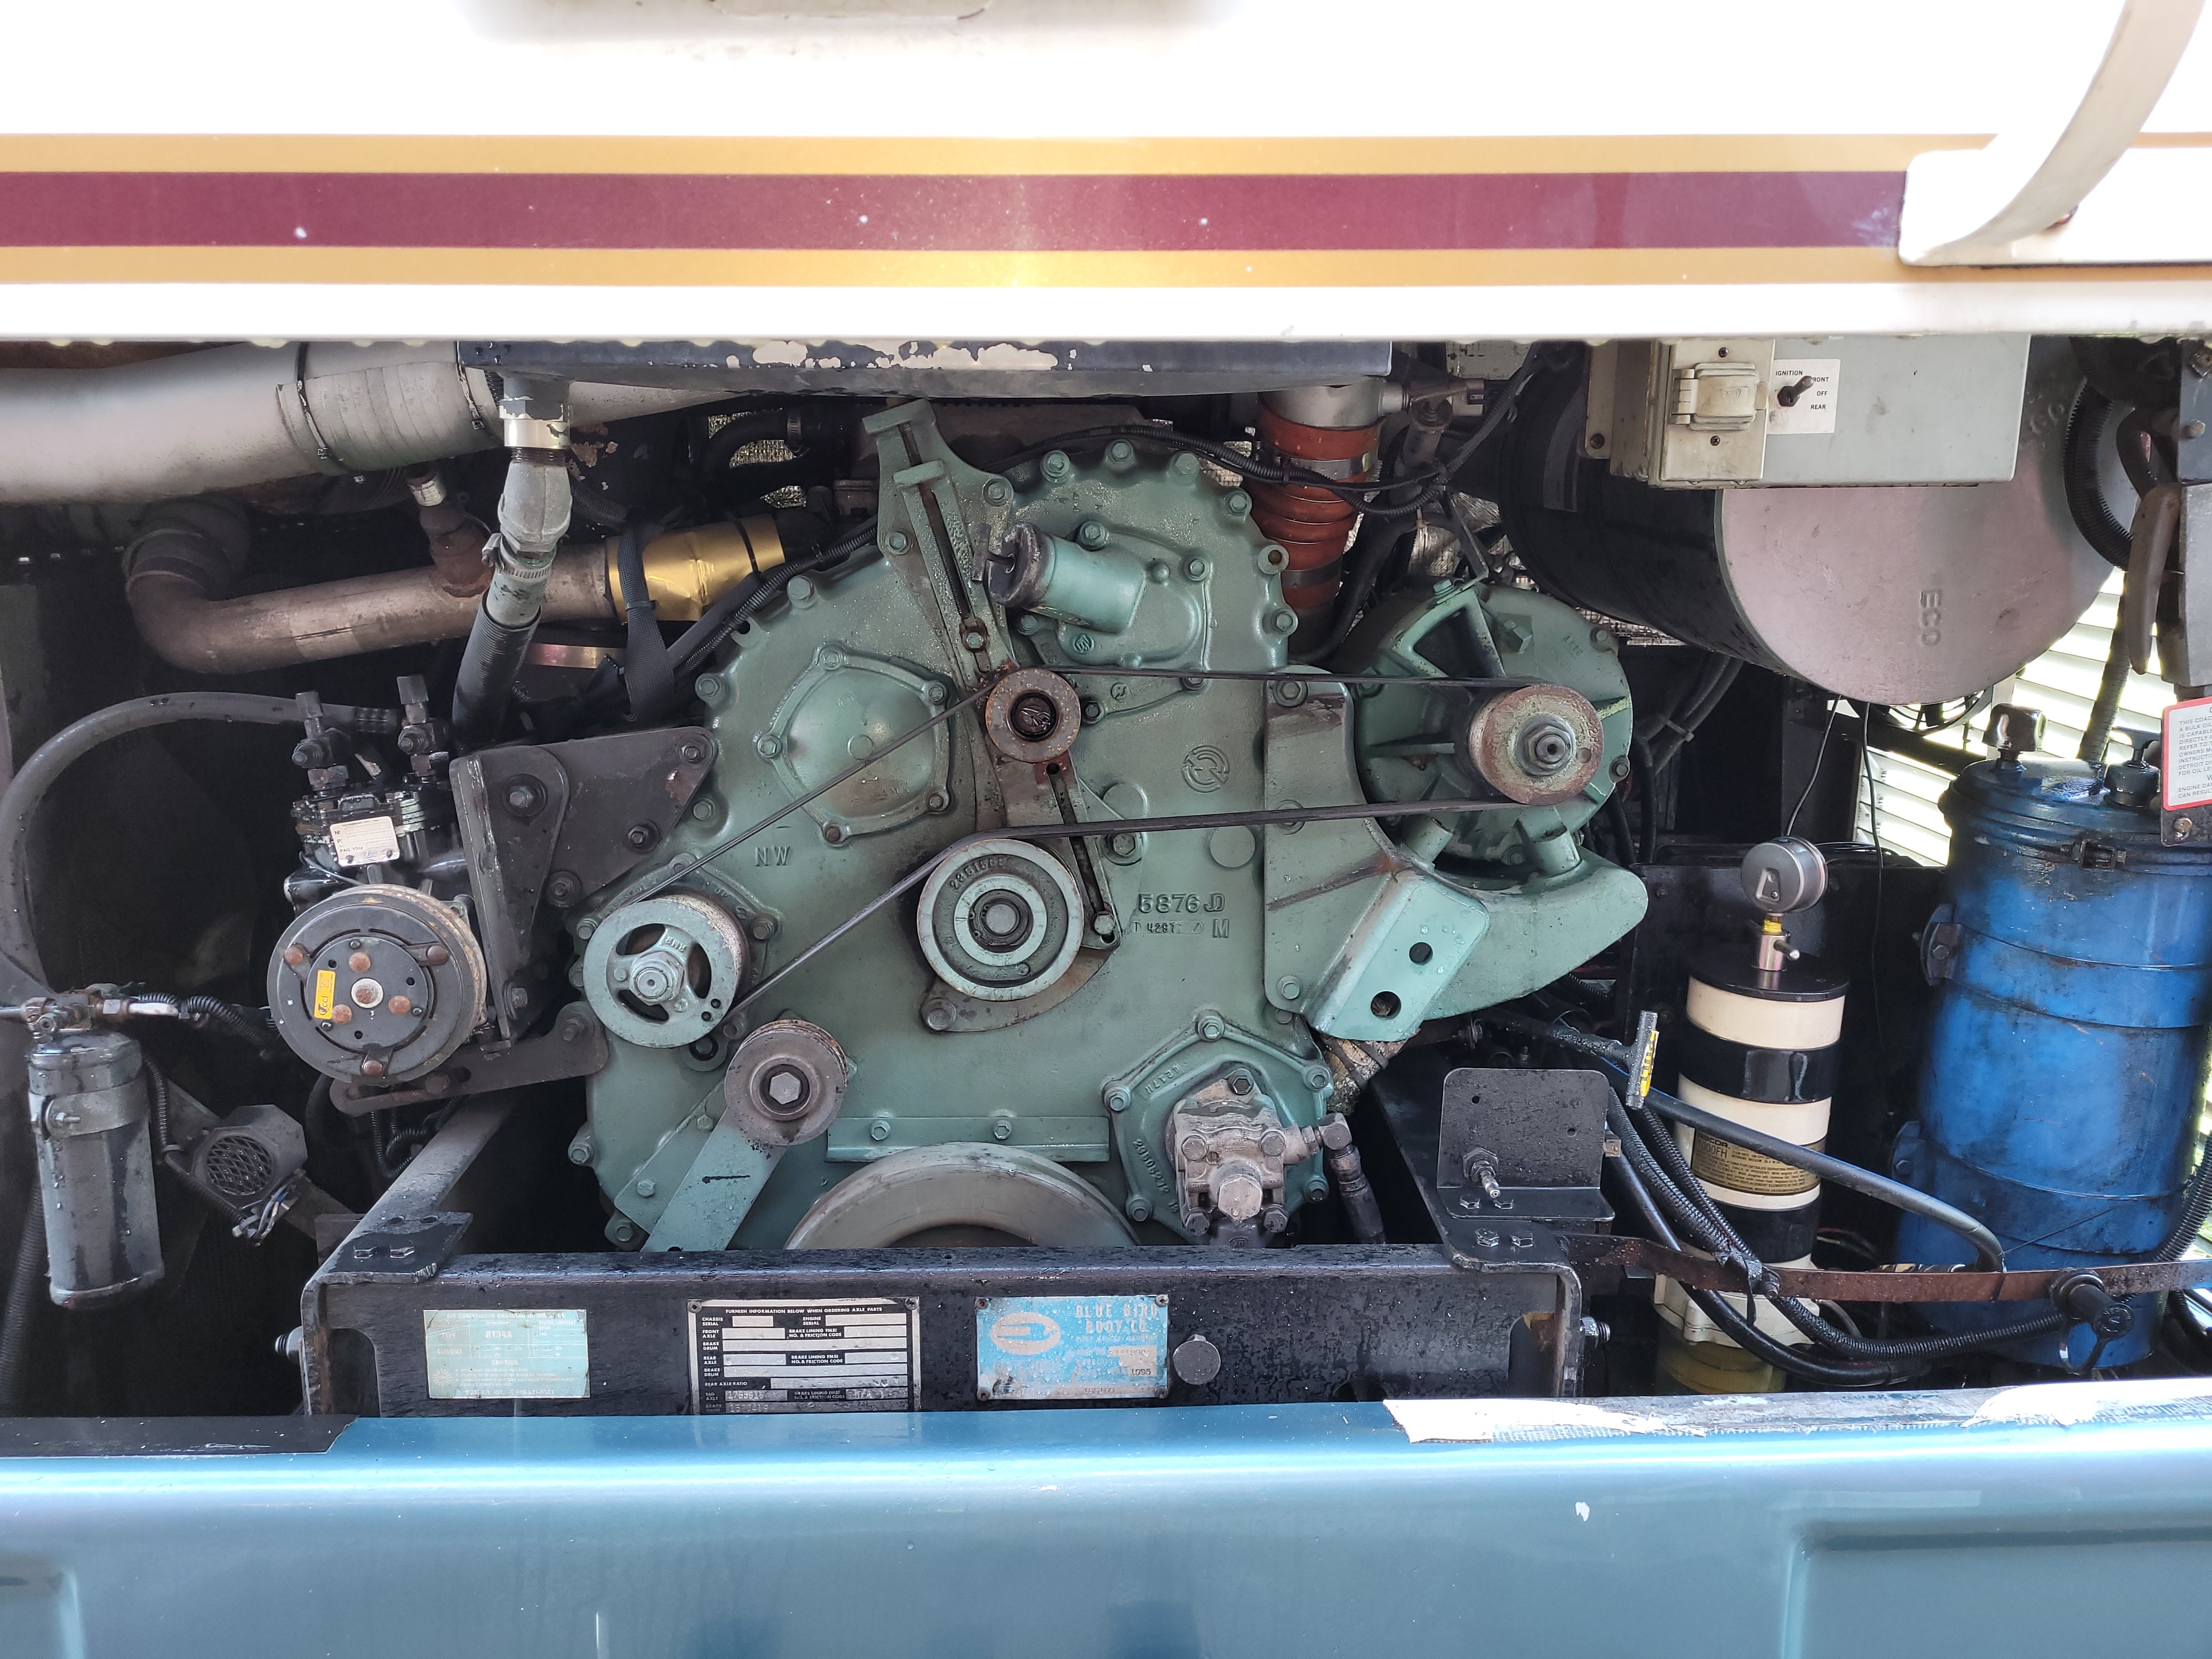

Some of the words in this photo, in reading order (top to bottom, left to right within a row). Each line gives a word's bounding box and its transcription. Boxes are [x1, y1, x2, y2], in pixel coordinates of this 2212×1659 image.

[2179, 736, 2208, 744] DIRECTLY
[2179, 749, 2204, 757] OWNERS
[2179, 761, 2204, 770] DETROIT
[1076, 1305, 1113, 1318] BLUE
[1124, 1303, 1158, 1317] BIRD
[1086, 1320, 1122, 1334] BODY
